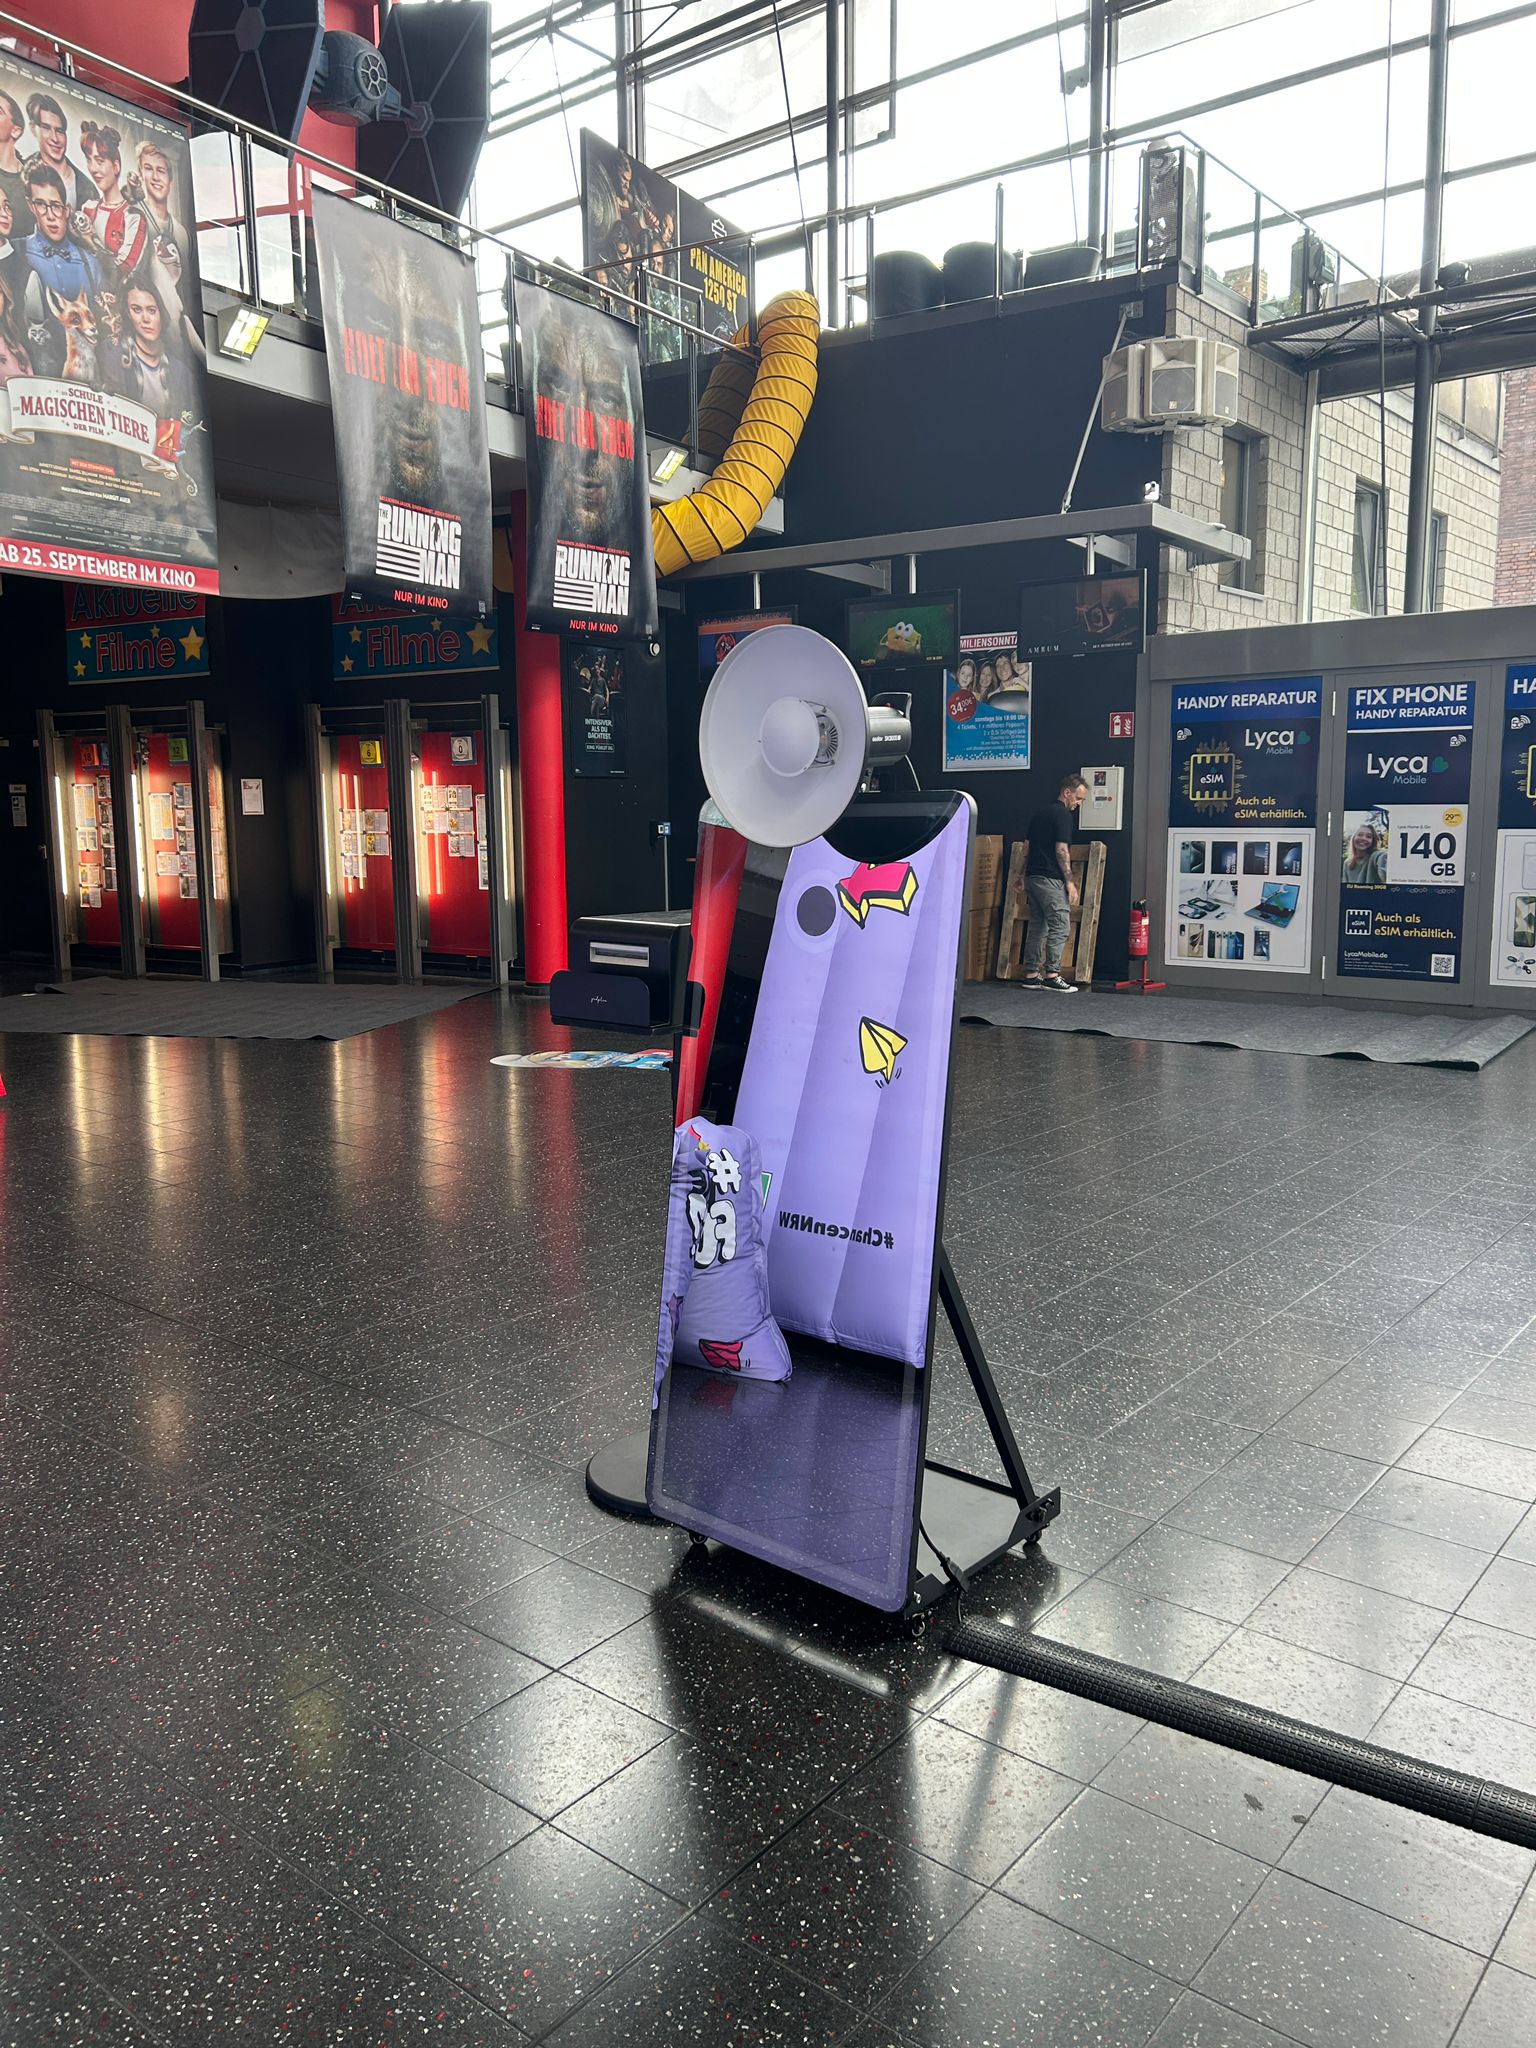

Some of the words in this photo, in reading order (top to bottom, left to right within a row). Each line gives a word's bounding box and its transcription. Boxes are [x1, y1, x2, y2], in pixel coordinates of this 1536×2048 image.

[690, 247, 708, 275] PAN
[710, 255, 747, 298] AMERICA
[68, 387, 104, 404] SCHULE
[20, 395, 106, 427] MAGISCHEN
[108, 410, 150, 444] TIERE
[73, 422, 88, 432] DER
[88, 425, 105, 436] FILM
[377, 502, 462, 557] RUNNING
[0, 543, 19, 563] AB
[21, 547, 46, 567] 25.
[49, 550, 137, 581] SEPTEMBER
[140, 565, 158, 583] IM
[160, 568, 196, 588] KINO
[420, 548, 461, 590] MAN
[555, 544, 631, 587] RUNNING
[394, 590, 412, 603] NUR
[414, 593, 426, 606] IM
[427, 596, 448, 609] KINO
[592, 581, 630, 616] MAN
[569, 619, 586, 630] NUR
[588, 621, 597, 631] IM
[599, 622, 618, 634] KINO
[96, 631, 177, 673] Filme
[367, 625, 461, 668] Filme
[1177, 694, 1228, 710] HANDY
[1231, 690, 1317, 707] REPARATUR
[1355, 688, 1387, 706] FIX
[1392, 684, 1468, 704] PHONE
[1356, 708, 1397, 719] HANDY
[1399, 705, 1467, 718] REPARATUR
[1244, 729, 1294, 750] Lyca
[1266, 746, 1294, 755] Mobile
[1367, 753, 1428, 778] Lyca
[1200, 774, 1224, 784] eSIM
[1393, 775, 1427, 785] Mobile
[1235, 796, 1260, 805] Auch
[1261, 796, 1276, 805] als
[1234, 809, 1259, 819] eSIM
[1260, 809, 1307, 819] erhältlich.
[1400, 832, 1457, 860] 140
[1430, 862, 1456, 876] GB
[1375, 912, 1402, 923] Auch
[1404, 913, 1421, 924] als
[1374, 926, 1401, 936] eSIM
[1403, 927, 1457, 939] erhältlich.
[1344, 950, 1388, 959] LycaMobile.de
